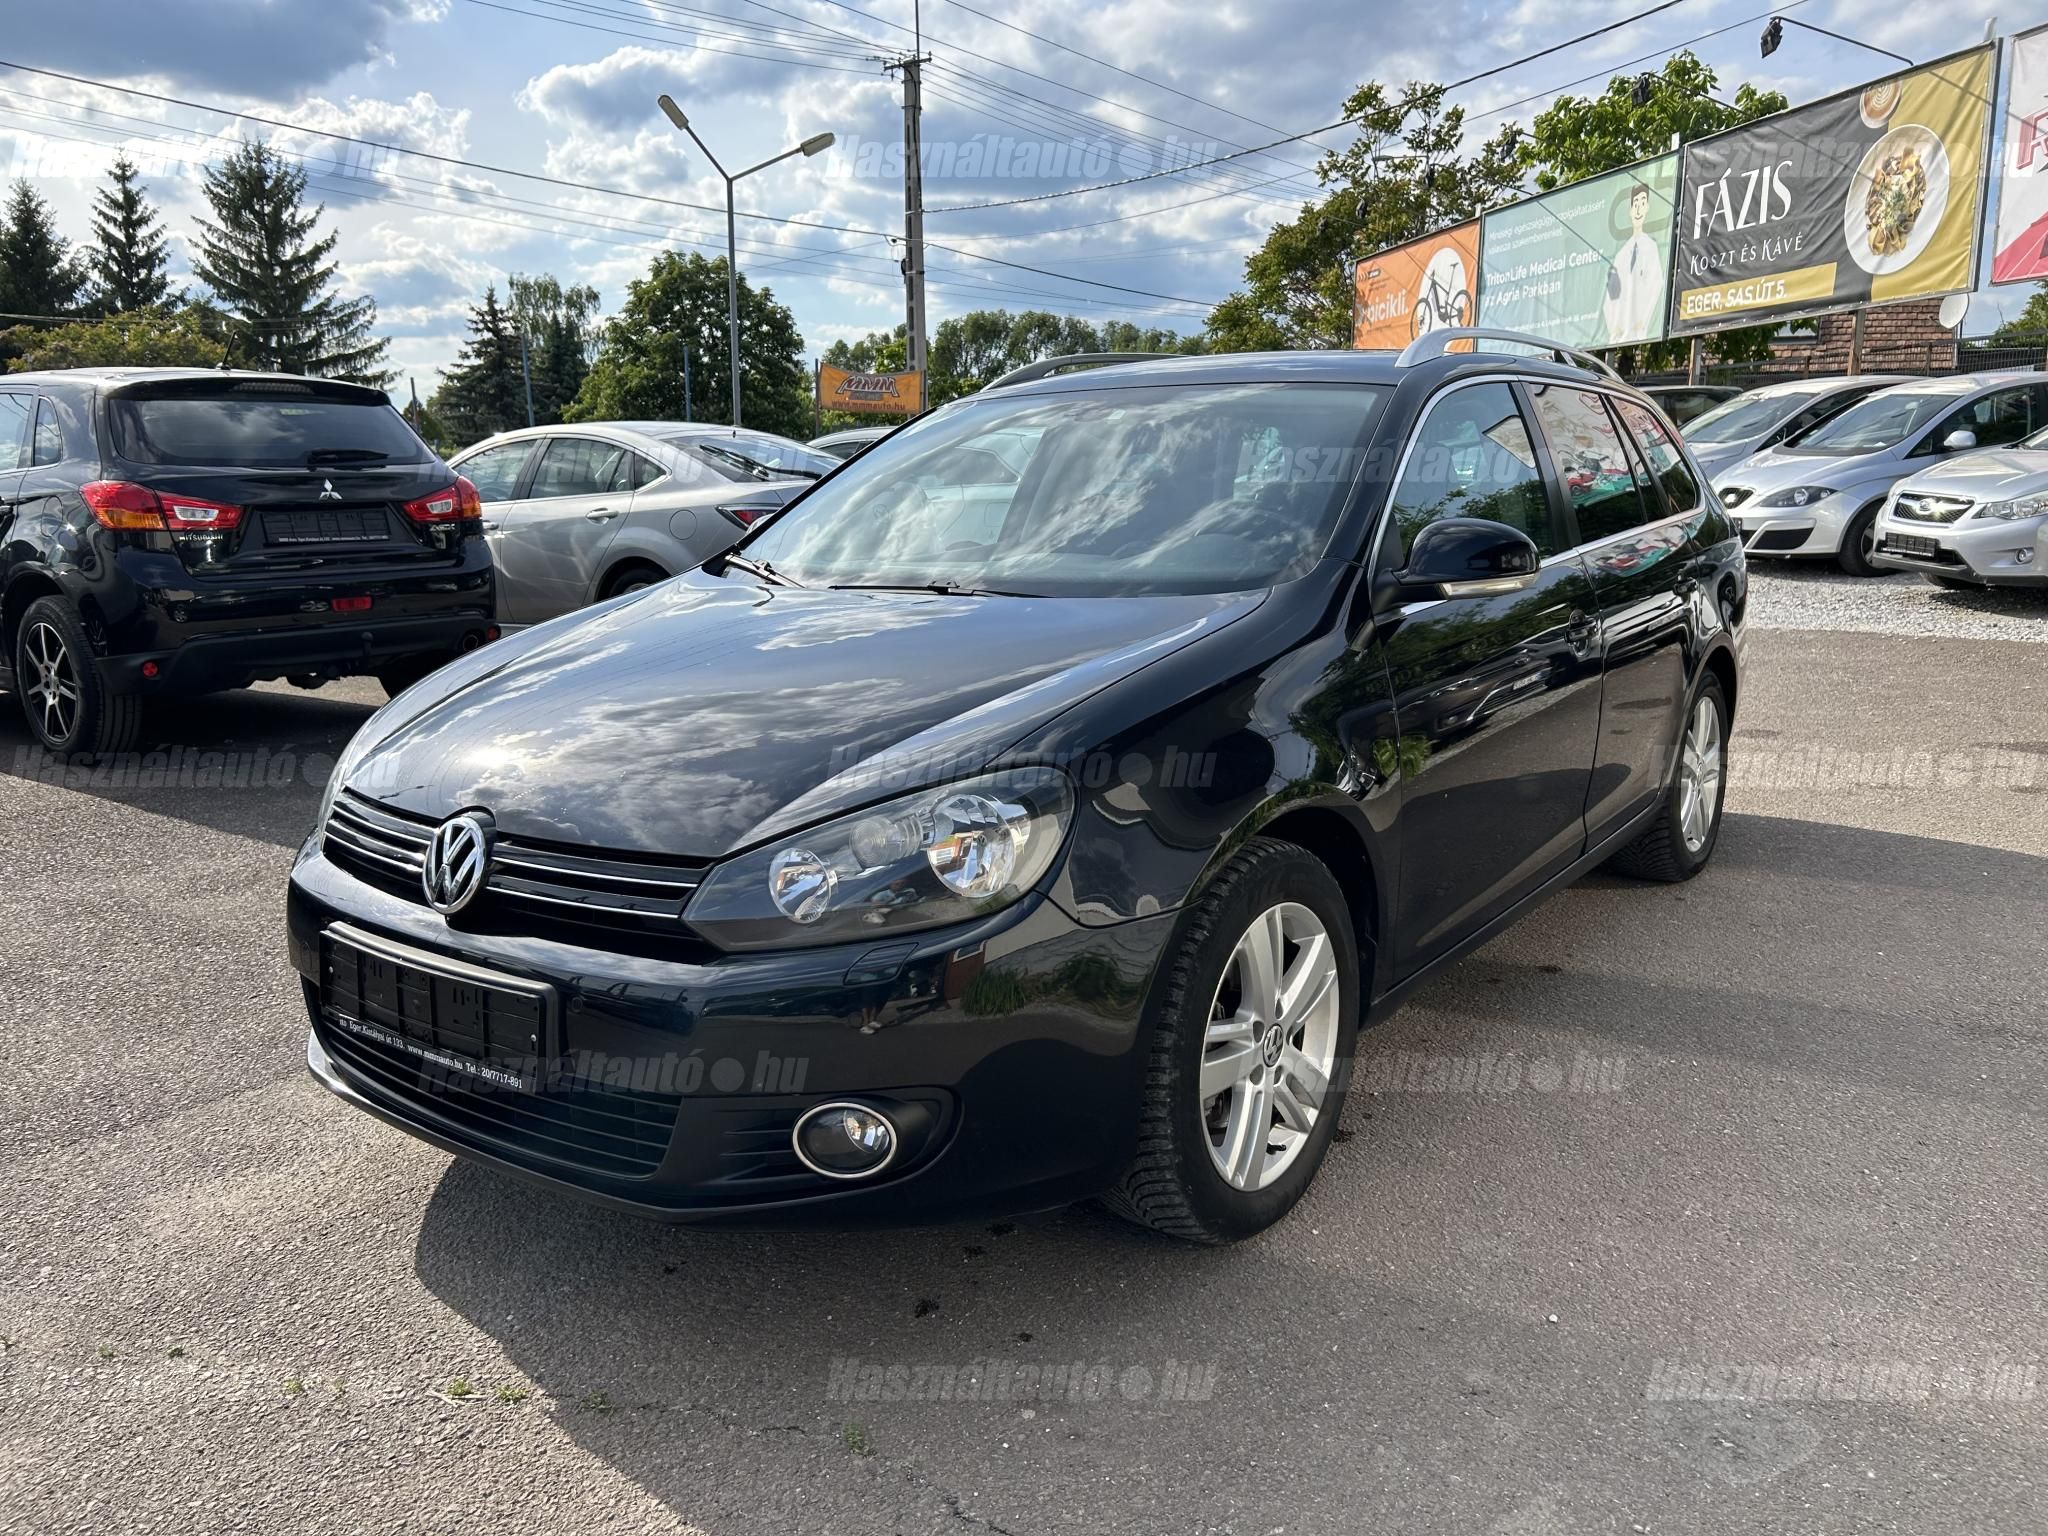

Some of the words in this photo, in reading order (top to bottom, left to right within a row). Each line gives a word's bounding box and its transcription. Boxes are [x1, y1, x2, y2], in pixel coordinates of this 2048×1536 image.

[1693, 160, 1793, 240] FÁZIS
[1529, 254, 1567, 276] Medical
[1569, 249, 1604, 267] Center
[1690, 249, 1736, 276] KOSZT
[1740, 243, 1757, 263] ÉS
[1762, 231, 1803, 261] KÁVÉ
[1496, 287, 1520, 306] Agria
[1522, 280, 1561, 298] Parkban
[1686, 291, 1723, 315] EGER,
[1725, 285, 1755, 308] SAS
[1756, 278, 1776, 301] ÚT
